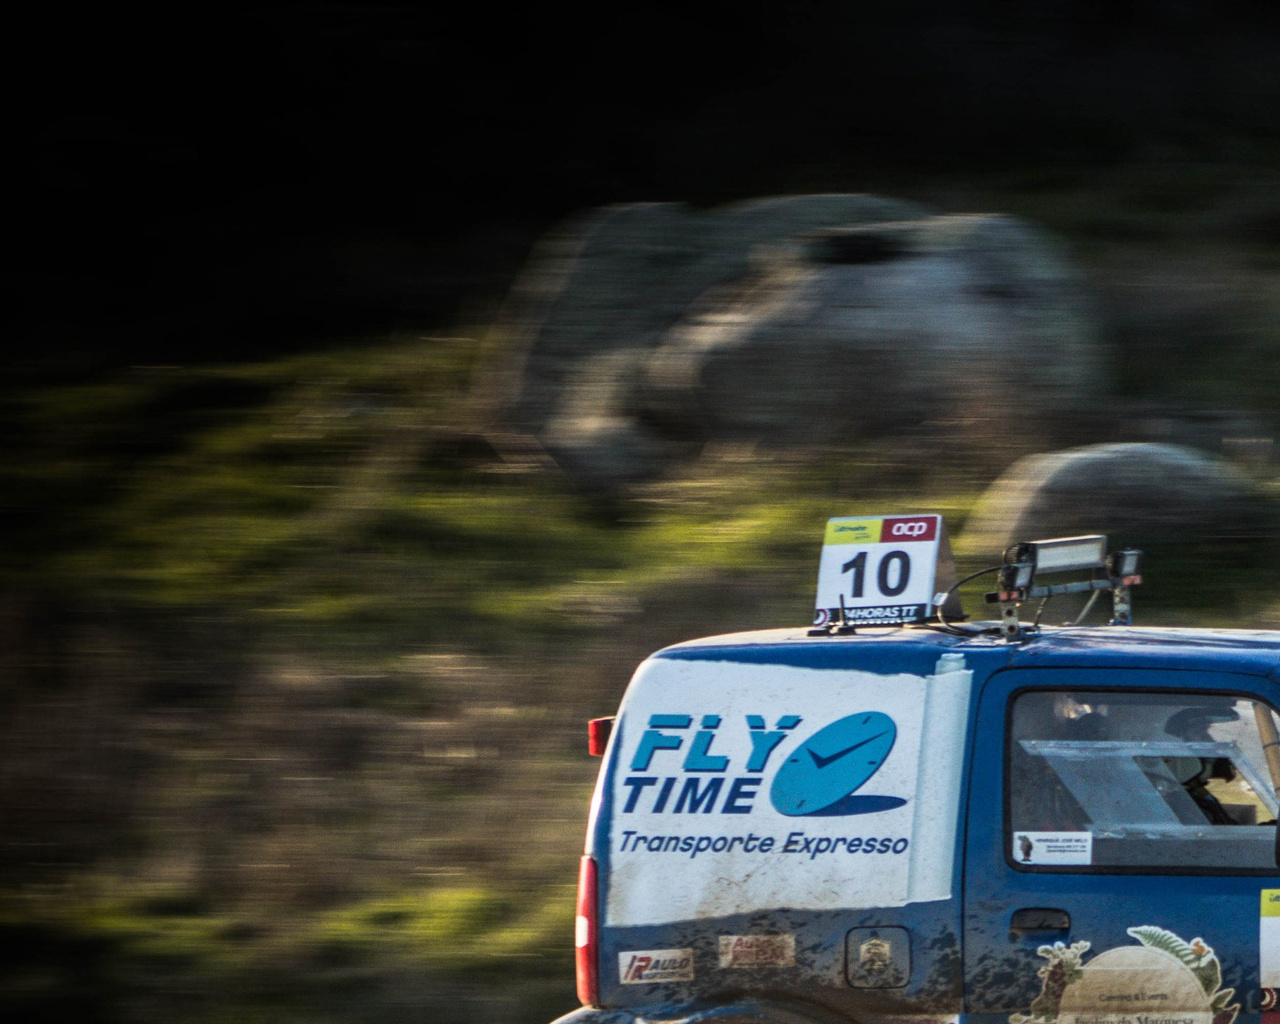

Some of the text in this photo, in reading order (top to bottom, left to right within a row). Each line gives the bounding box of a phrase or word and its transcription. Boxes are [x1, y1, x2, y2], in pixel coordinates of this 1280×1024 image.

[892, 522, 928, 536] acp
[841, 550, 911, 598] 10
[901, 606, 919, 616] TT
[630, 714, 803, 773] FLY
[622, 777, 763, 814] TIME
[619, 831, 909, 859] Transporte Expresso
